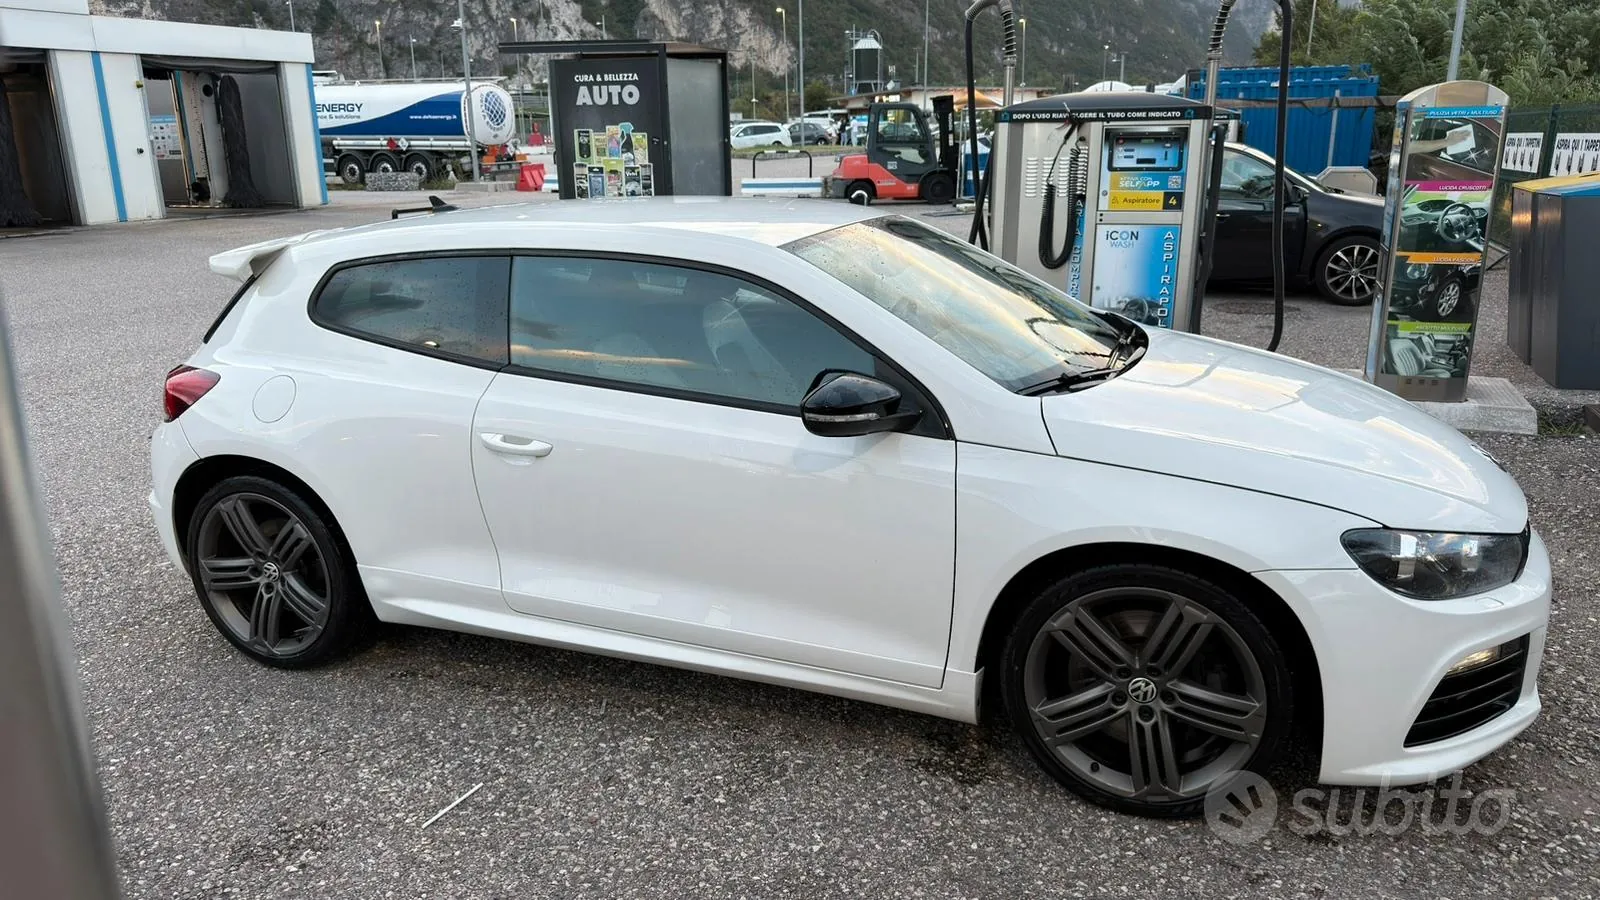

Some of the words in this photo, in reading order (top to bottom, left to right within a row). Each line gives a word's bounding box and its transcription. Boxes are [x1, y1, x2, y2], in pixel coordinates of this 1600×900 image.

[574, 75, 595, 83] CURA
[596, 74, 602, 82] &
[604, 73, 639, 81] BELLEZZA
[575, 84, 640, 106] AUTO
[316, 103, 363, 113] ENERGY
[1122, 196, 1161, 205] Aspiratore
[1168, 195, 1177, 206] 4
[1109, 240, 1135, 248] WASH
